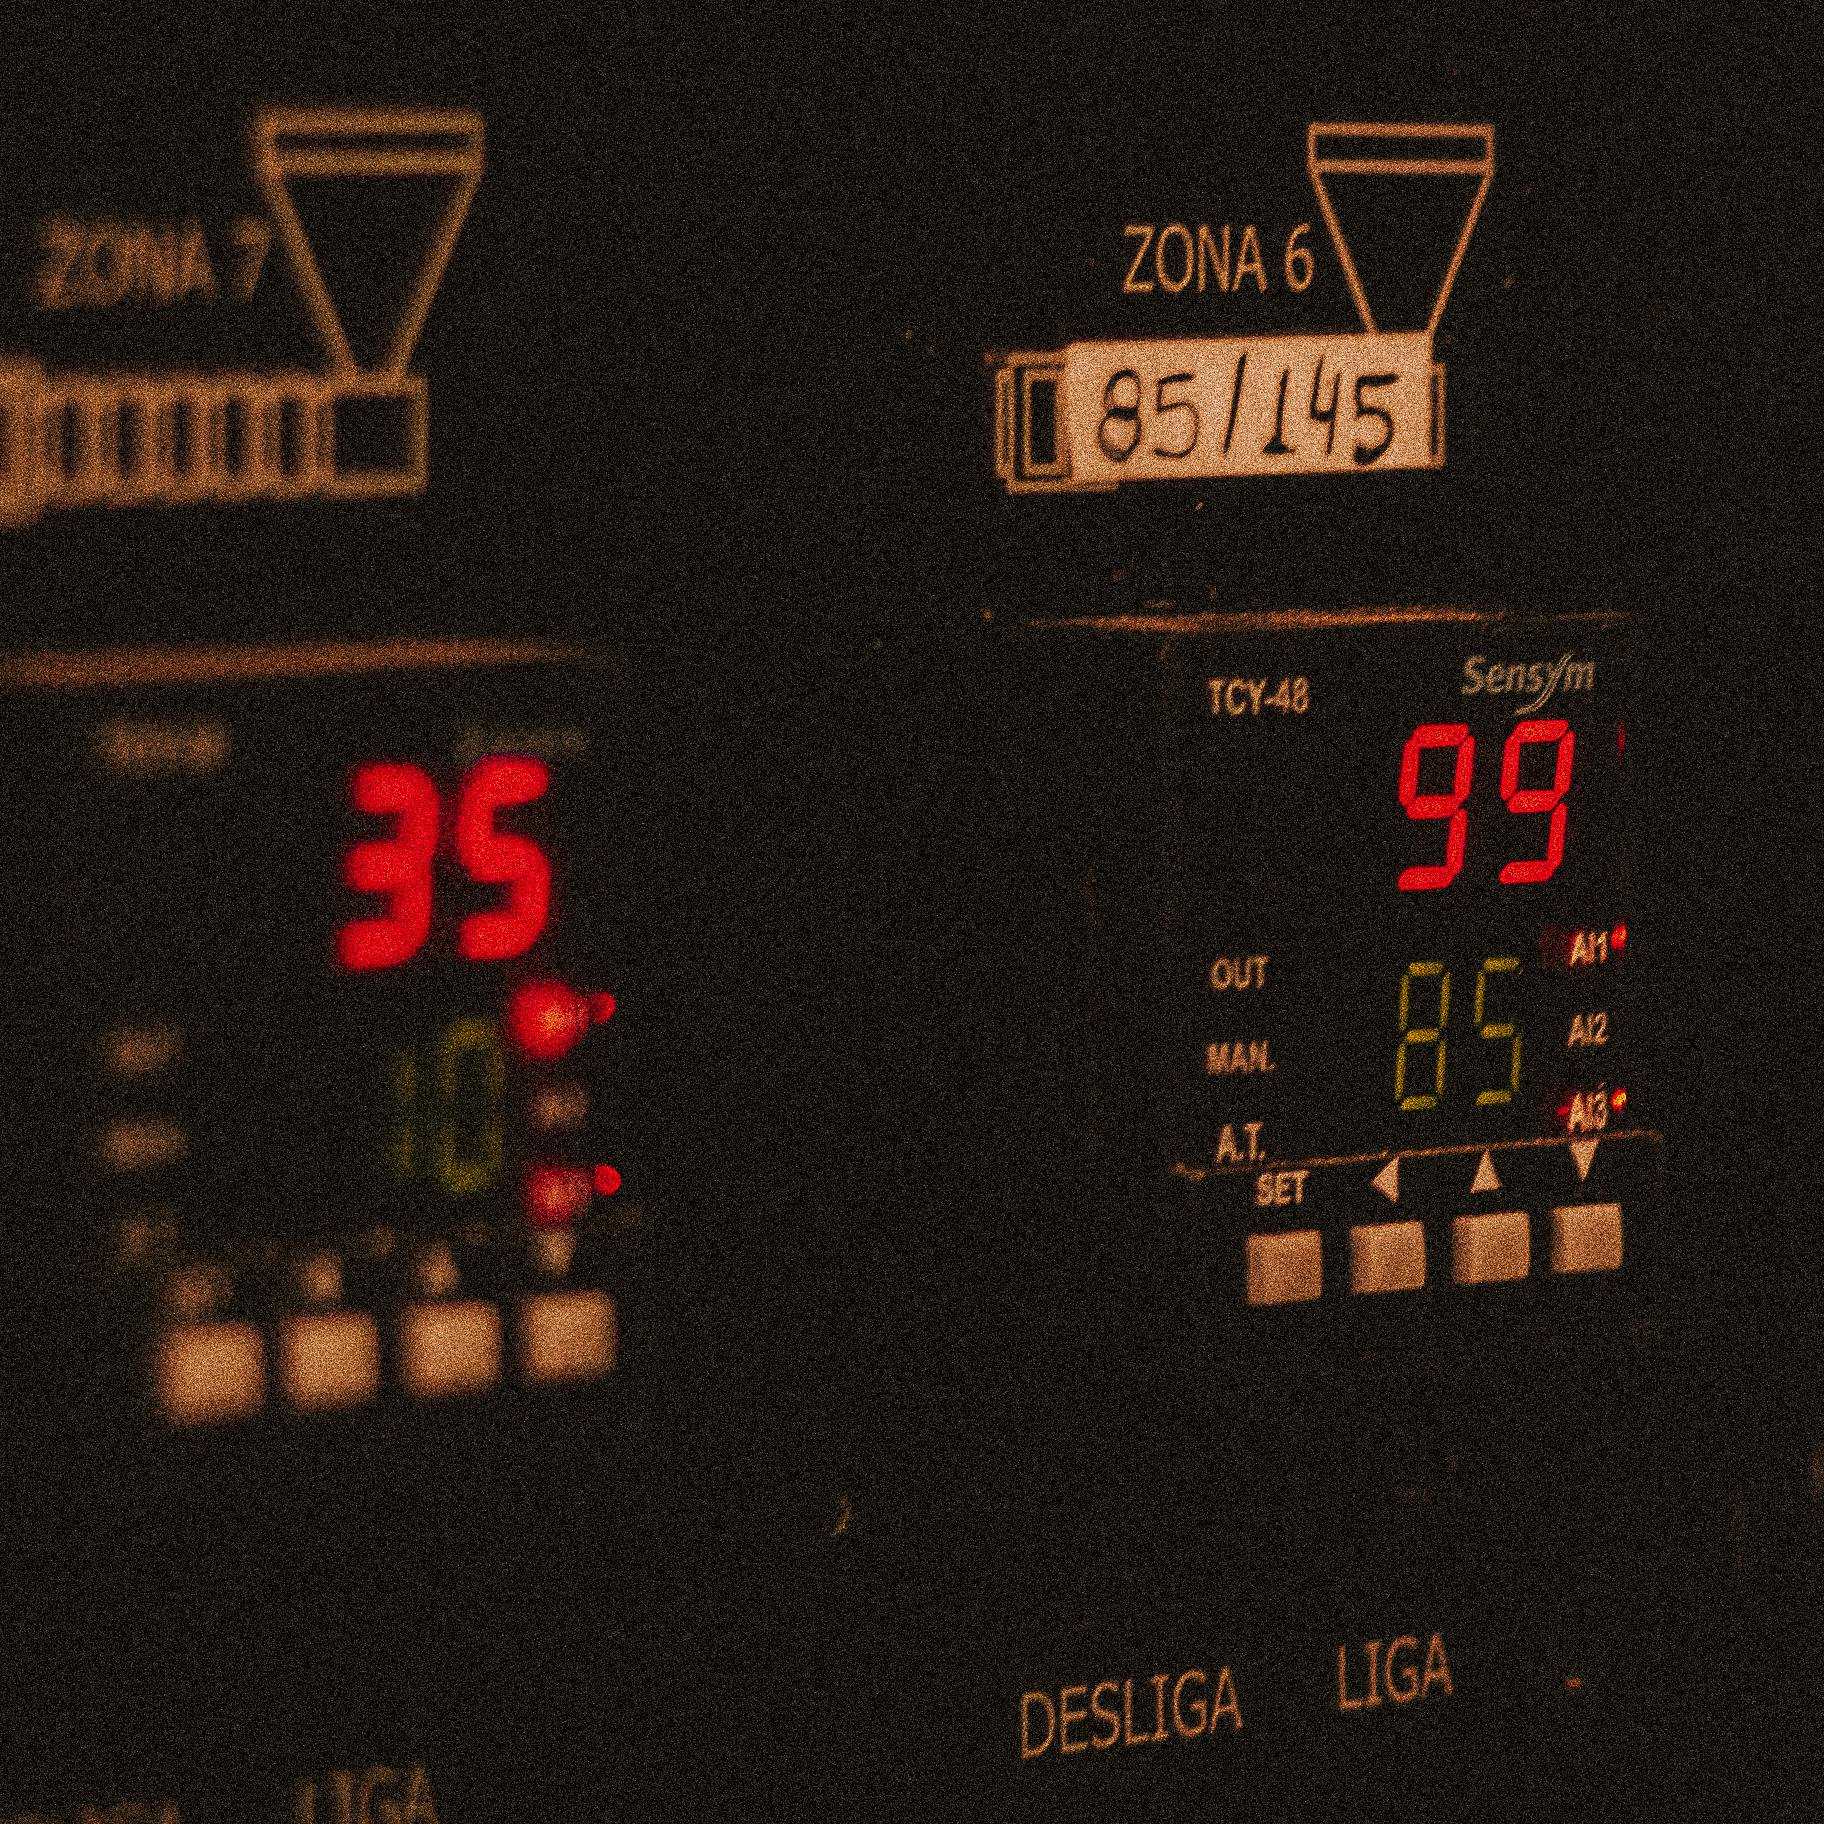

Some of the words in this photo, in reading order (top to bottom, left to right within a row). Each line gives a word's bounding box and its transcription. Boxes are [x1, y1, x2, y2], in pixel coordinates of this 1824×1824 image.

[36, 214, 217, 310] ZONA
[1122, 221, 1269, 295] ZONA
[1283, 221, 1316, 293] 6
[1097, 351, 1400, 466] 85/145
[1207, 675, 1311, 717] TCY-48
[1460, 651, 1597, 717] Sensym
[1397, 717, 1576, 892] 99
[335, 754, 553, 972] 35
[1208, 954, 1270, 992] OUT
[1205, 1039, 1277, 1076] MAN.
[1394, 957, 1523, 1113] 85
[1214, 1120, 1267, 1165] A.T.
[1254, 1169, 1310, 1208] SET
[1019, 1664, 1245, 1762] DESLIGA
[1336, 1631, 1455, 1713] LIGA
